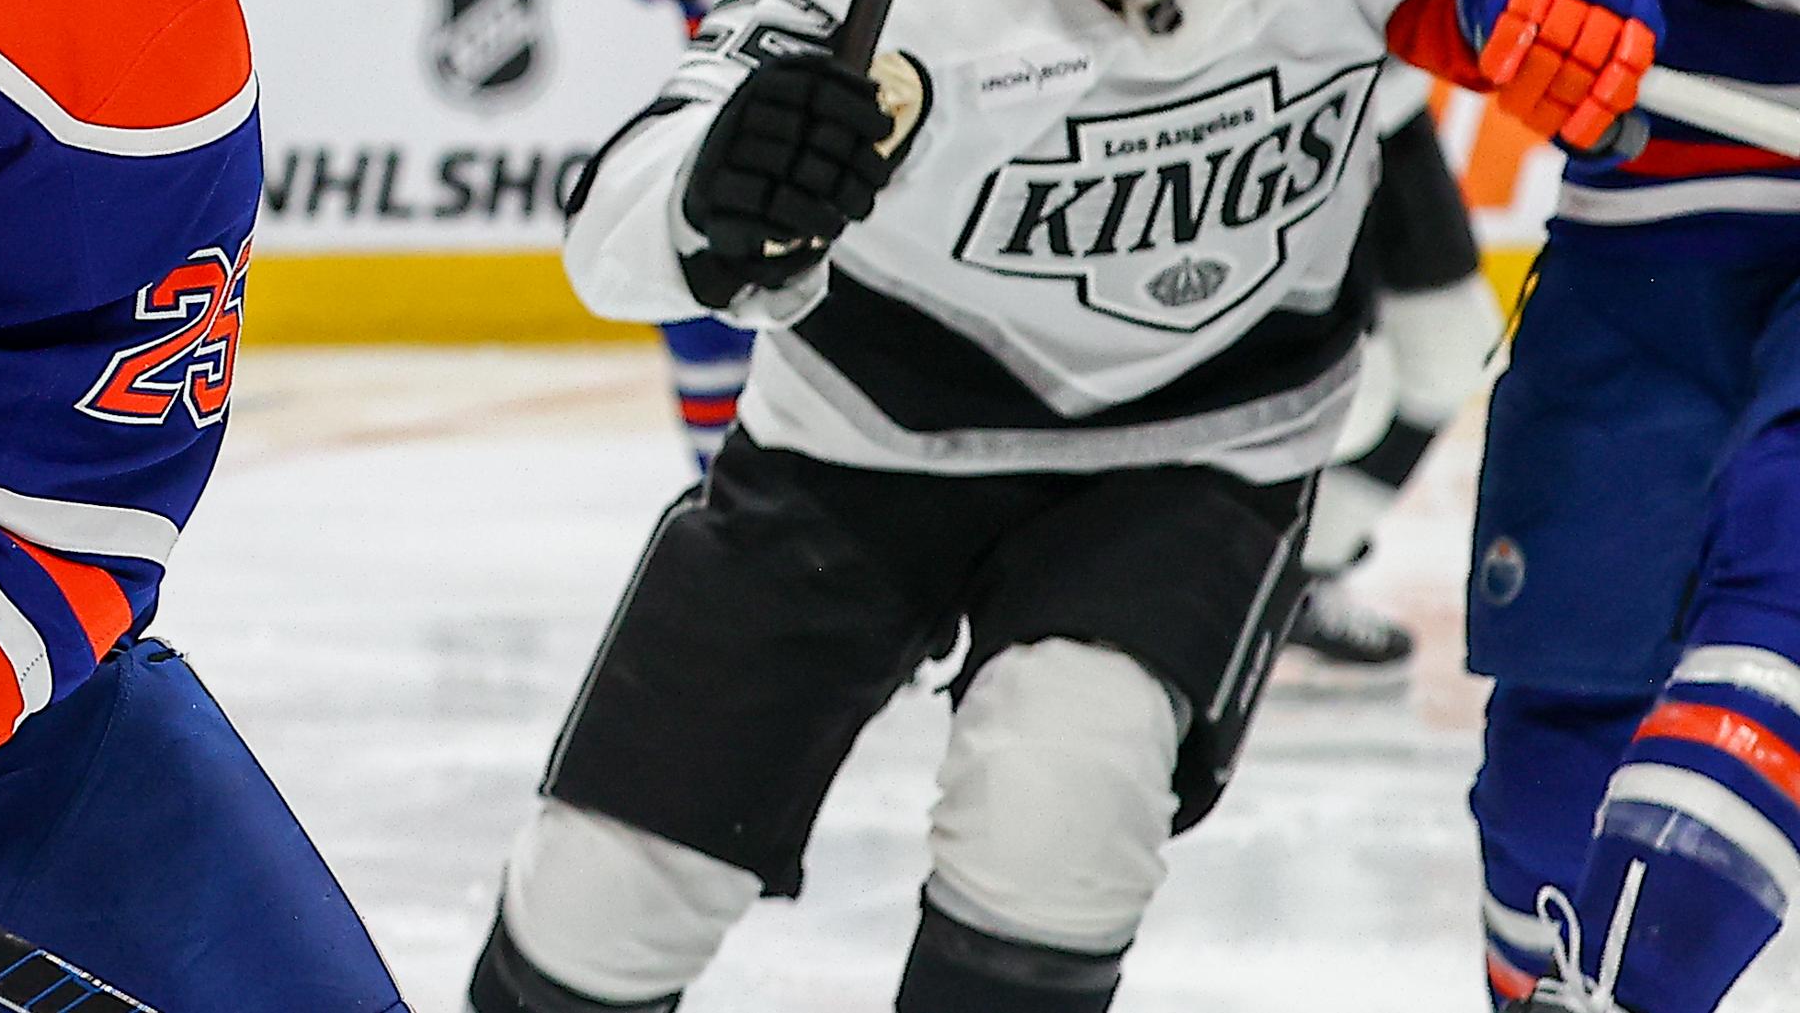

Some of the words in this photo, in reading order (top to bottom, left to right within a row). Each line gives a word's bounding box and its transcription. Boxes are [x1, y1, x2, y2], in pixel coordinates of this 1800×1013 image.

[999, 89, 1348, 258] KINGS
[1104, 137, 1149, 158] Los
[1156, 107, 1256, 149] Angeles
[73, 231, 255, 429] 25
